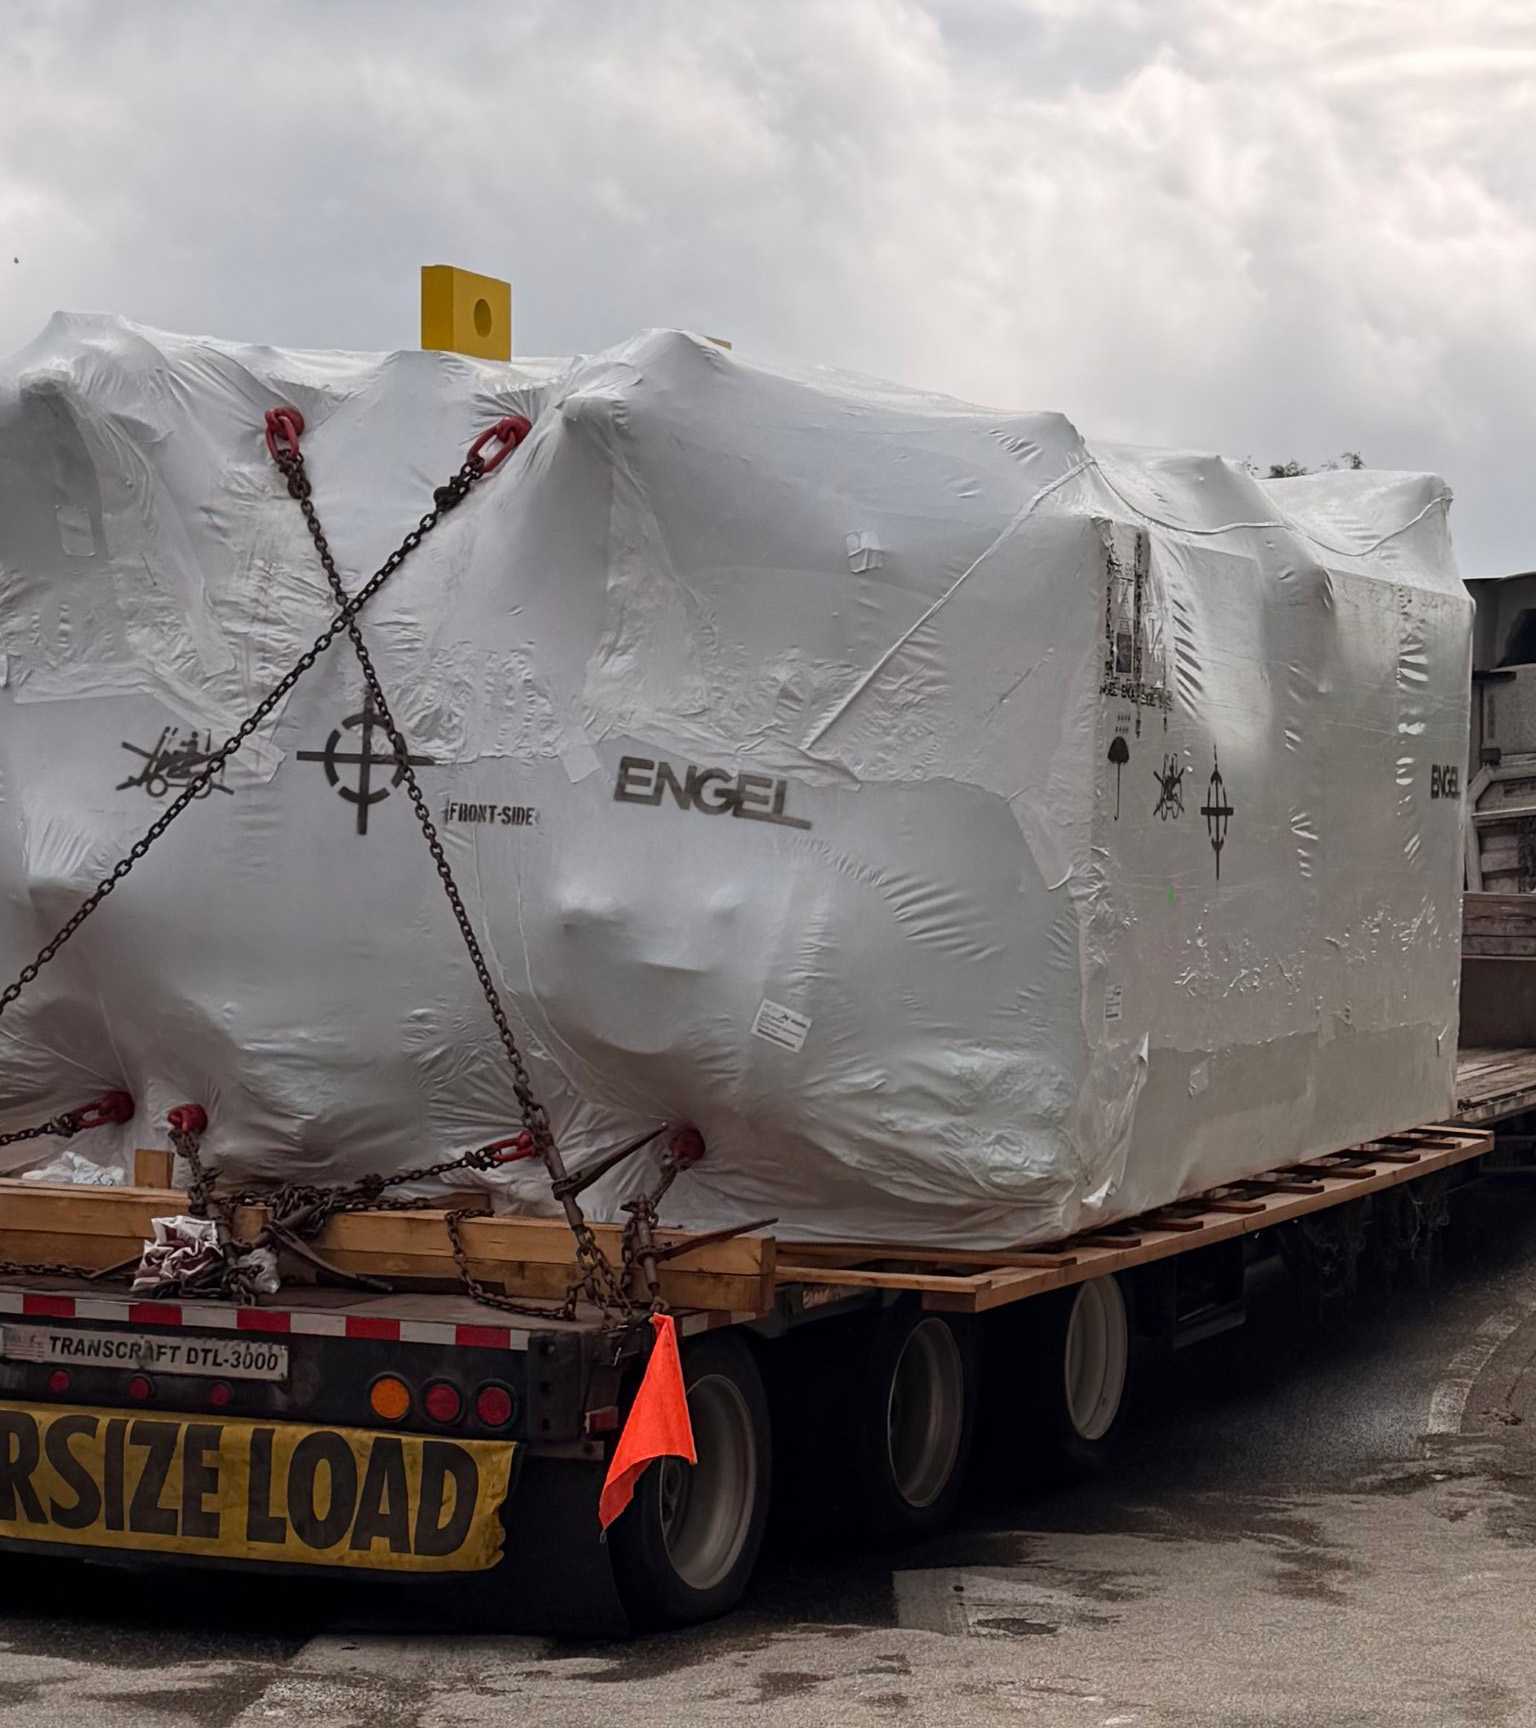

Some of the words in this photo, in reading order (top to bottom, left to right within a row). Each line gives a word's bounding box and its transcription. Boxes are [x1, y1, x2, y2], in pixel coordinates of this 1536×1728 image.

[613, 755, 812, 830] ENGEL
[50, 1335, 180, 1364] TRANSCRAFT
[185, 1347, 279, 1371] DTL-3000
[246, 1427, 480, 1558] LOAD
